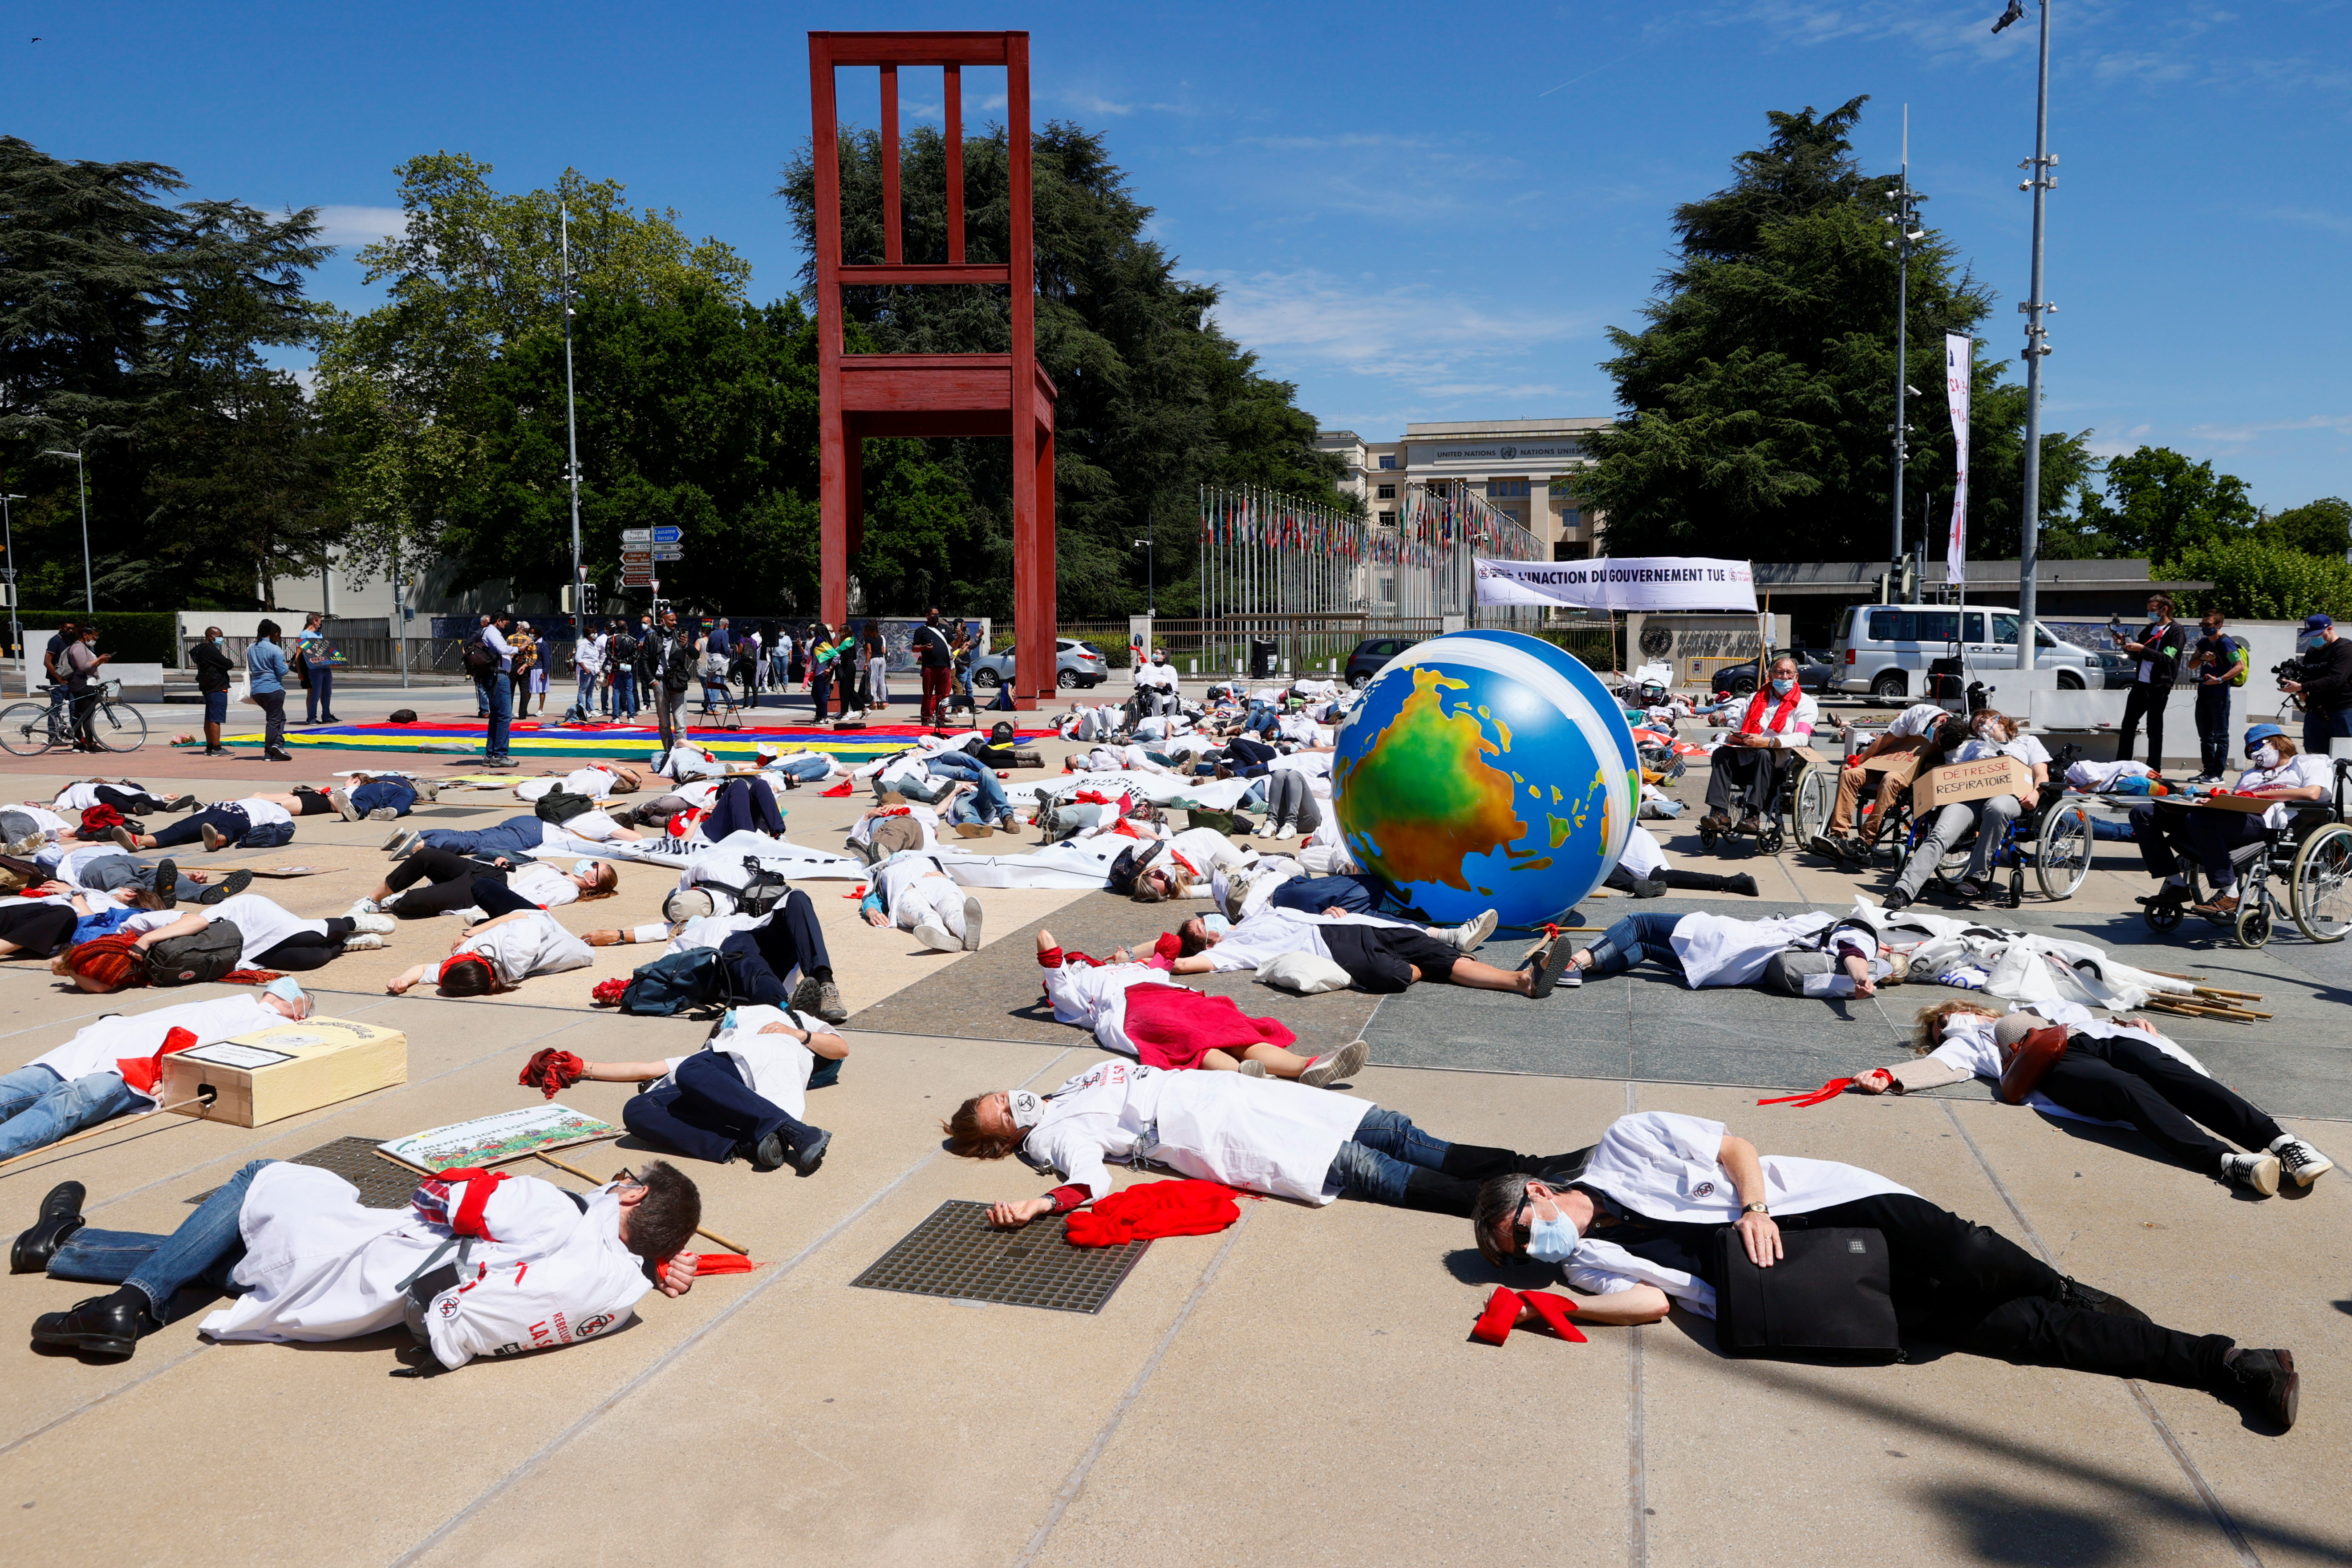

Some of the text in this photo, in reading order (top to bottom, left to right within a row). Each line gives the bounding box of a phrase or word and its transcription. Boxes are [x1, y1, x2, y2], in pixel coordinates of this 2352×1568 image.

[1518, 569, 1725, 584] L'INACTION DU GOUVERNEMENT TUE
[1943, 762, 2010, 780] DÉTRESSE
[420, 1122, 465, 1137] CLIMAT
[400, 1128, 503, 1155] ALIMENTATION
[529, 1321, 550, 1341] LA
